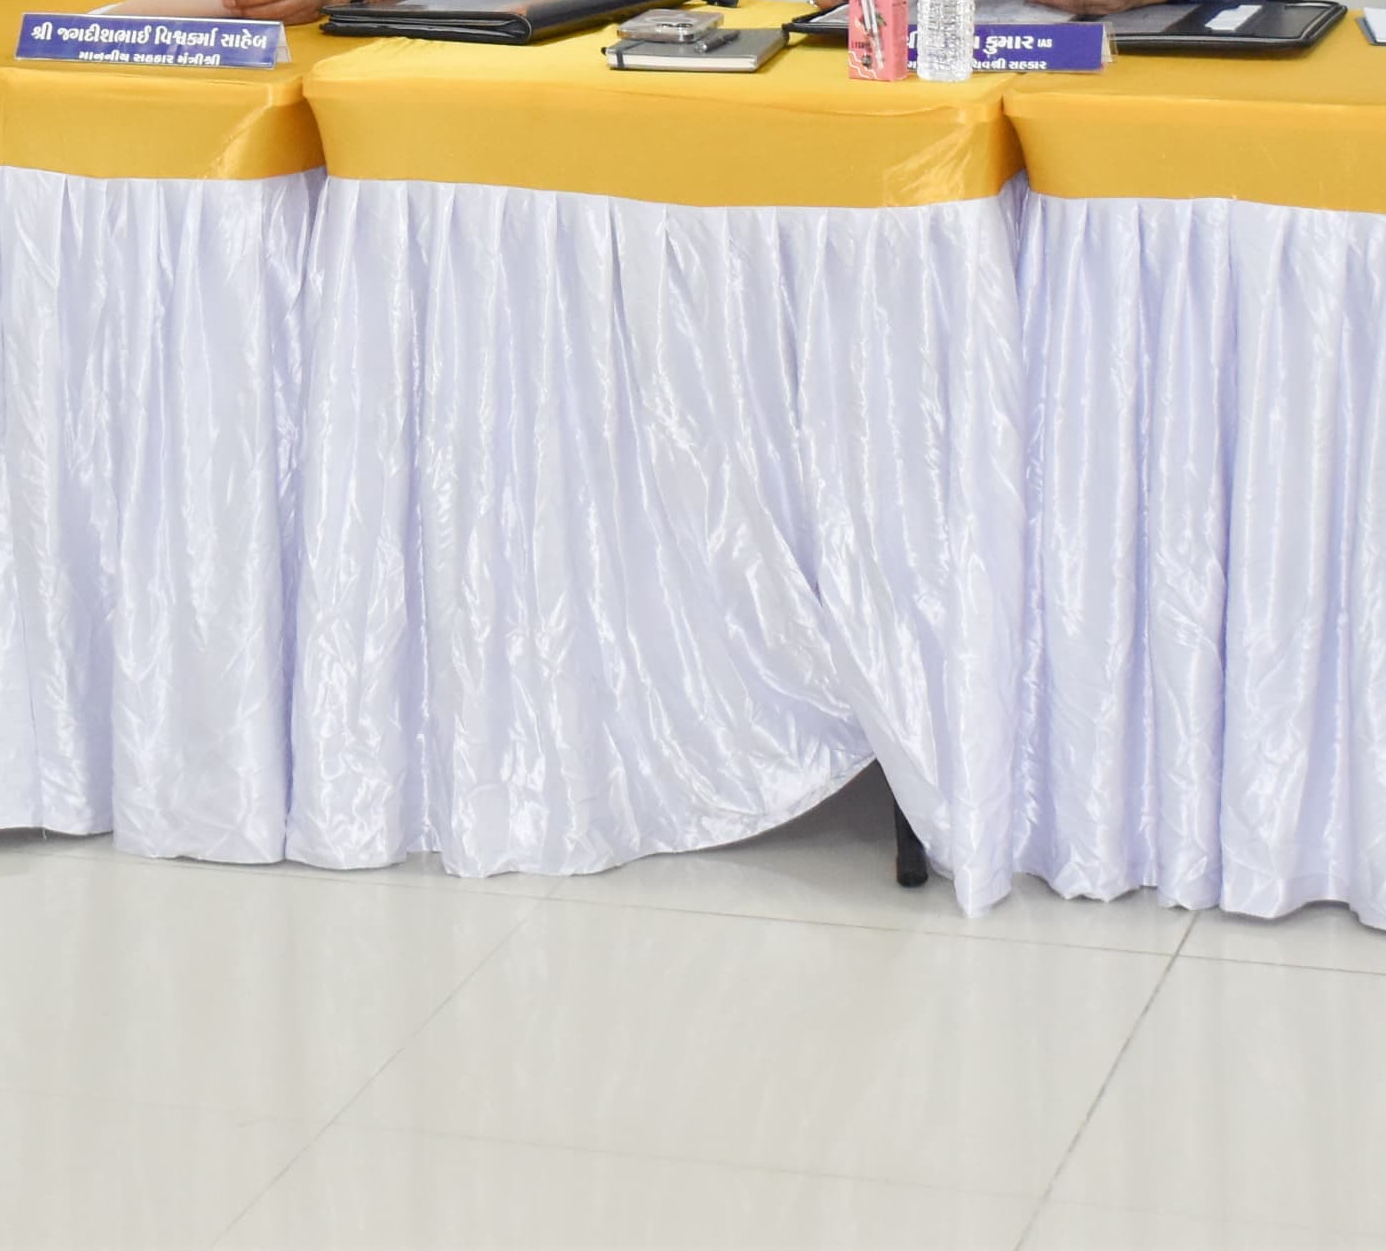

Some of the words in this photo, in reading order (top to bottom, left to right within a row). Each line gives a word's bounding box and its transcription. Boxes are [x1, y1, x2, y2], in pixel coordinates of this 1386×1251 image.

[31, 22, 52, 41] શ્રી
[57, 23, 152, 44] જગદીશભાઈ
[154, 27, 216, 47] વિશ્વકર્મા
[220, 28, 268, 50] સાહેબ
[983, 35, 1033, 56] કુમાર
[1037, 39, 1053, 49] IAS
[78, 50, 129, 63] માનનીય
[133, 53, 174, 65] સહકાર
[1008, 60, 1048, 71] સહકાર
